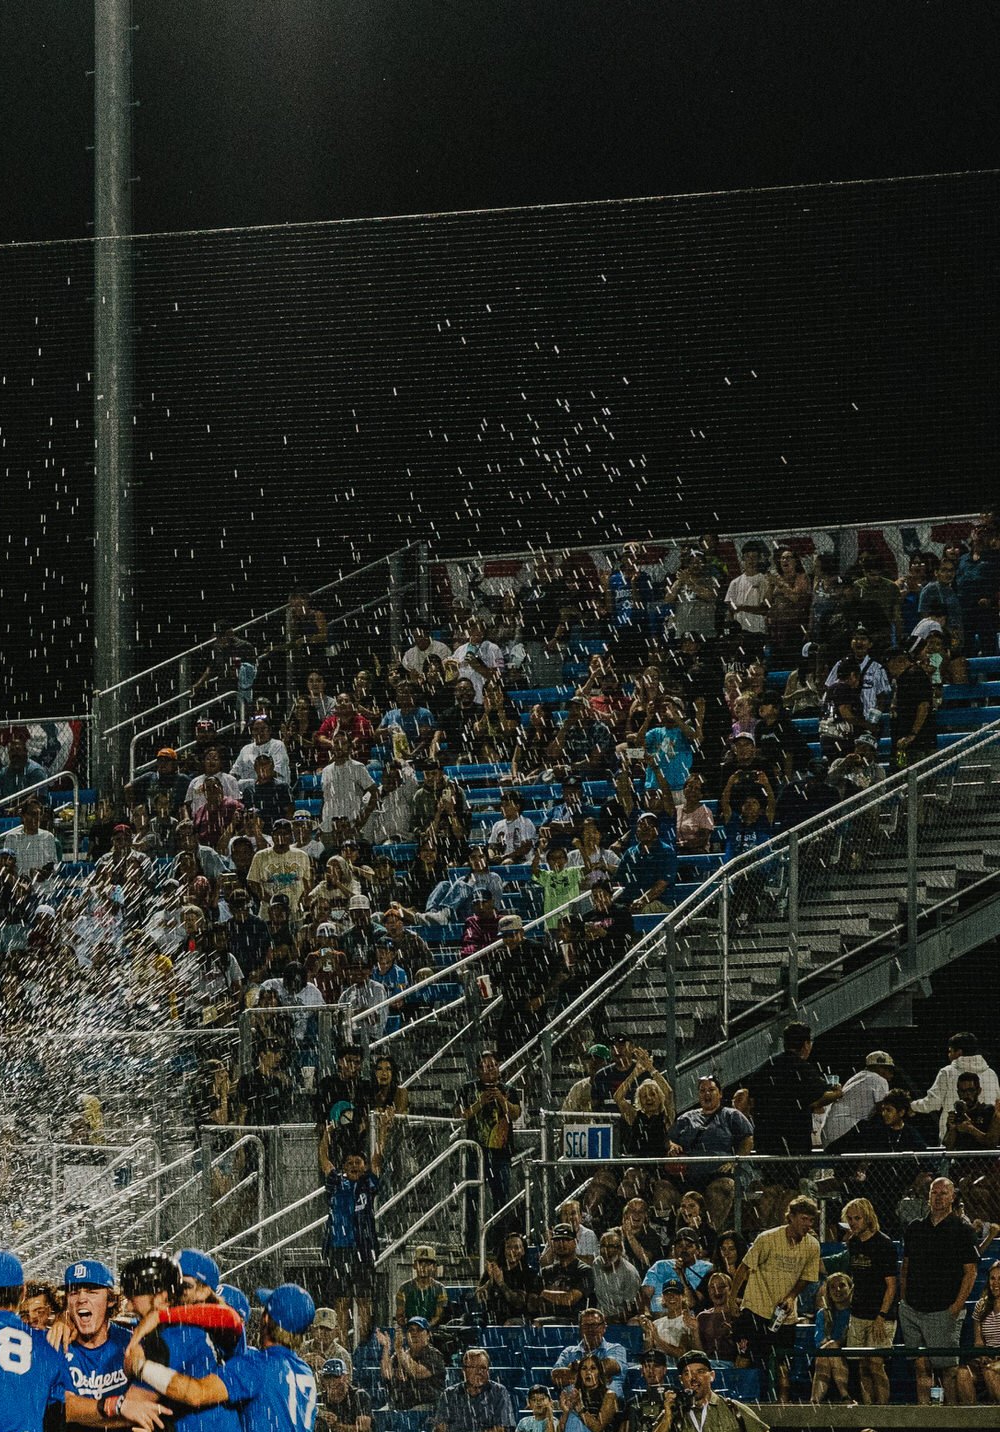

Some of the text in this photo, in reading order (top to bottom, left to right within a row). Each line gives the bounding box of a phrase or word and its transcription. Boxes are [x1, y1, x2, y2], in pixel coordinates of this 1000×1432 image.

[565, 1130, 603, 1158] SEC 1
[69, 1366, 128, 1401] Dodgers
[284, 1360, 317, 1430] 17
